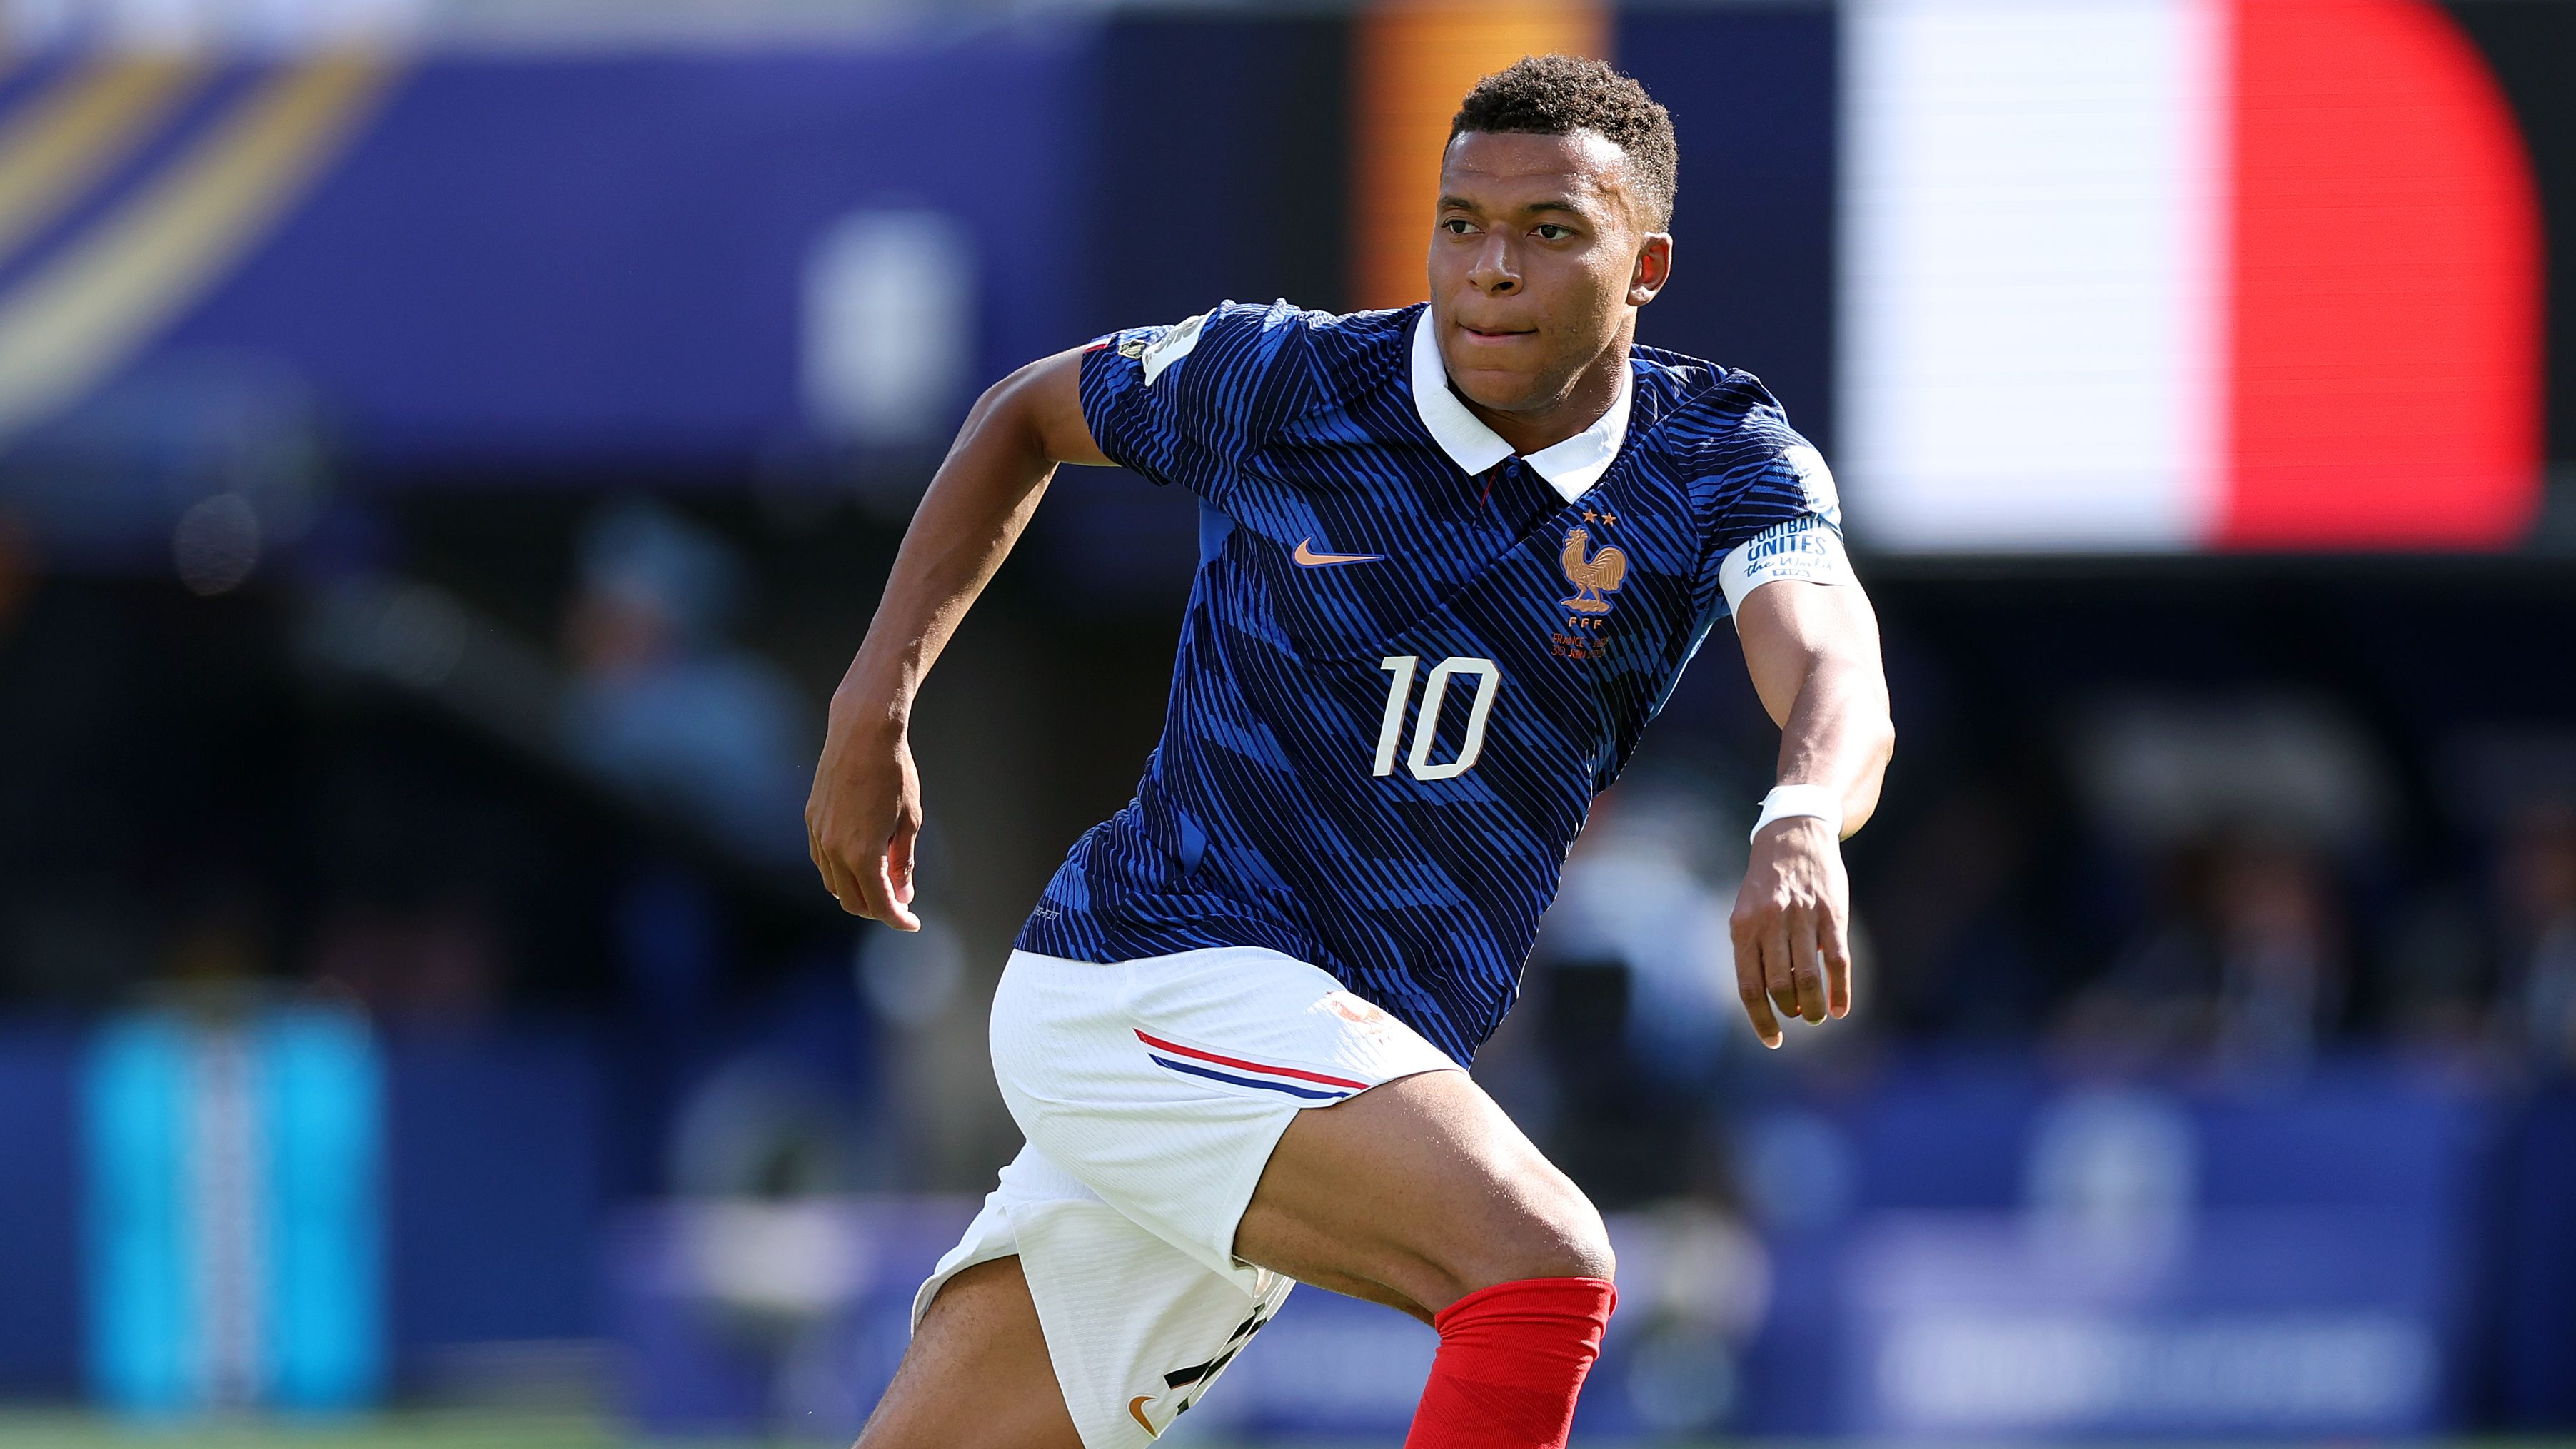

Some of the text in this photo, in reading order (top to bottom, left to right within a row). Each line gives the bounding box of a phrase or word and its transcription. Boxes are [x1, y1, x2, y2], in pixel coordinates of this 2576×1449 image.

[1747, 534, 1826, 562] UNITES
[1742, 560, 1775, 577] the
[1551, 645, 1566, 656] 30
[1372, 655, 1502, 781] 10
